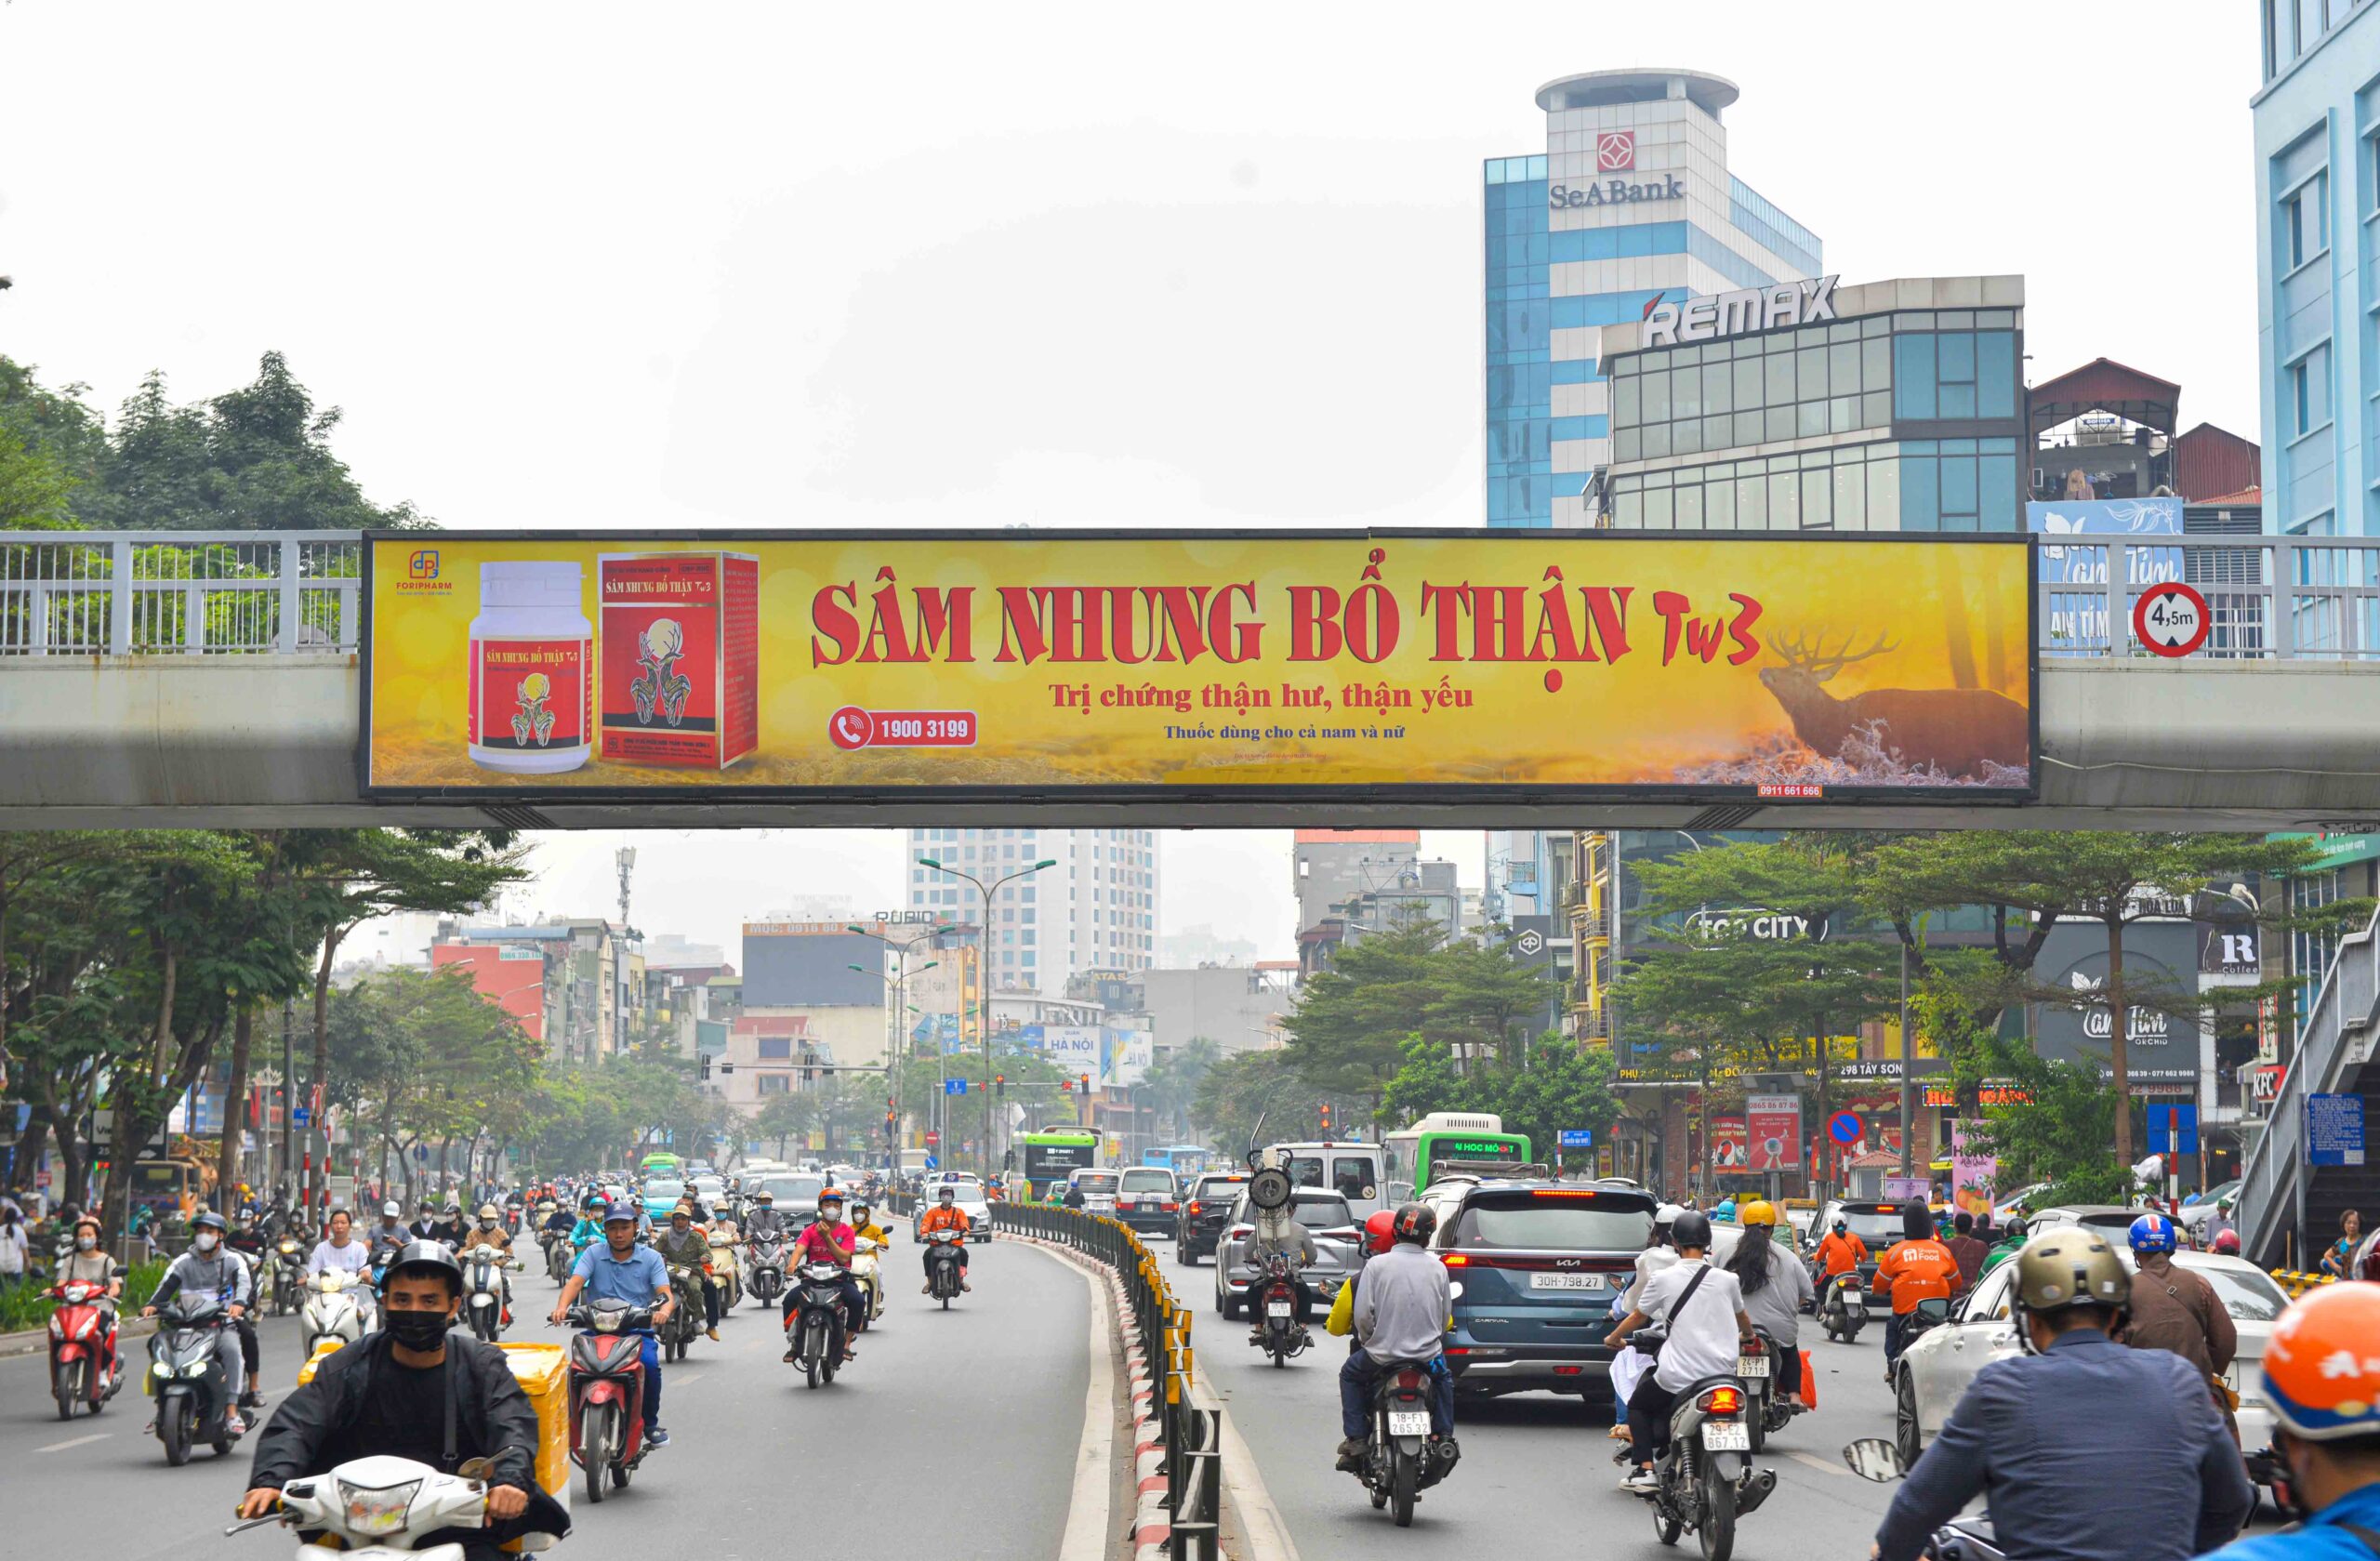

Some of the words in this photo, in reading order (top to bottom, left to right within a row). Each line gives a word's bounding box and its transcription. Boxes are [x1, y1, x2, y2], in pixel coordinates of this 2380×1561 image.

[1550, 174, 1684, 209] SeABank
[1642, 274, 1841, 349] REMAX
[626, 581, 654, 593] NHUNG
[812, 565, 977, 668] SÂM
[996, 580, 1267, 666] NHUNG
[1285, 548, 1401, 664] BỔ
[1421, 564, 1635, 694] THẬN
[2151, 603, 2193, 627] 4,5m
[1049, 683, 1091, 715] Trị
[1100, 681, 1192, 713] chứng
[1200, 681, 1272, 716] thận
[1281, 683, 1332, 713] hư,
[1342, 681, 1412, 716] thận
[1421, 675, 1474, 713] yếu
[881, 720, 922, 738] 1900
[927, 720, 968, 738] 3199
[1163, 721, 1215, 739] Thuốc
[1221, 724, 1261, 742] dùng
[1264, 725, 1293, 739] cho
[1299, 723, 1316, 739] cả
[1321, 727, 1356, 739] nam
[1361, 724, 1378, 739] và
[1383, 725, 1407, 739] nữ
[1760, 786, 1783, 796] 0911
[1785, 786, 1802, 796] 661
[1804, 786, 1819, 796] 666
[1753, 916, 1808, 939] CITY
[2221, 934, 2256, 963] R
[2223, 966, 2258, 974] Coffee
[1860, 1063, 1877, 1075] TÂY
[2253, 1071, 2274, 1097] KFC
[1919, 1253, 1939, 1262] Food
[1537, 1277, 1598, 1288] 30H-798.27
[1395, 1413, 1423, 1423] 18-F1
[1708, 1436, 1747, 1449] 867.12
